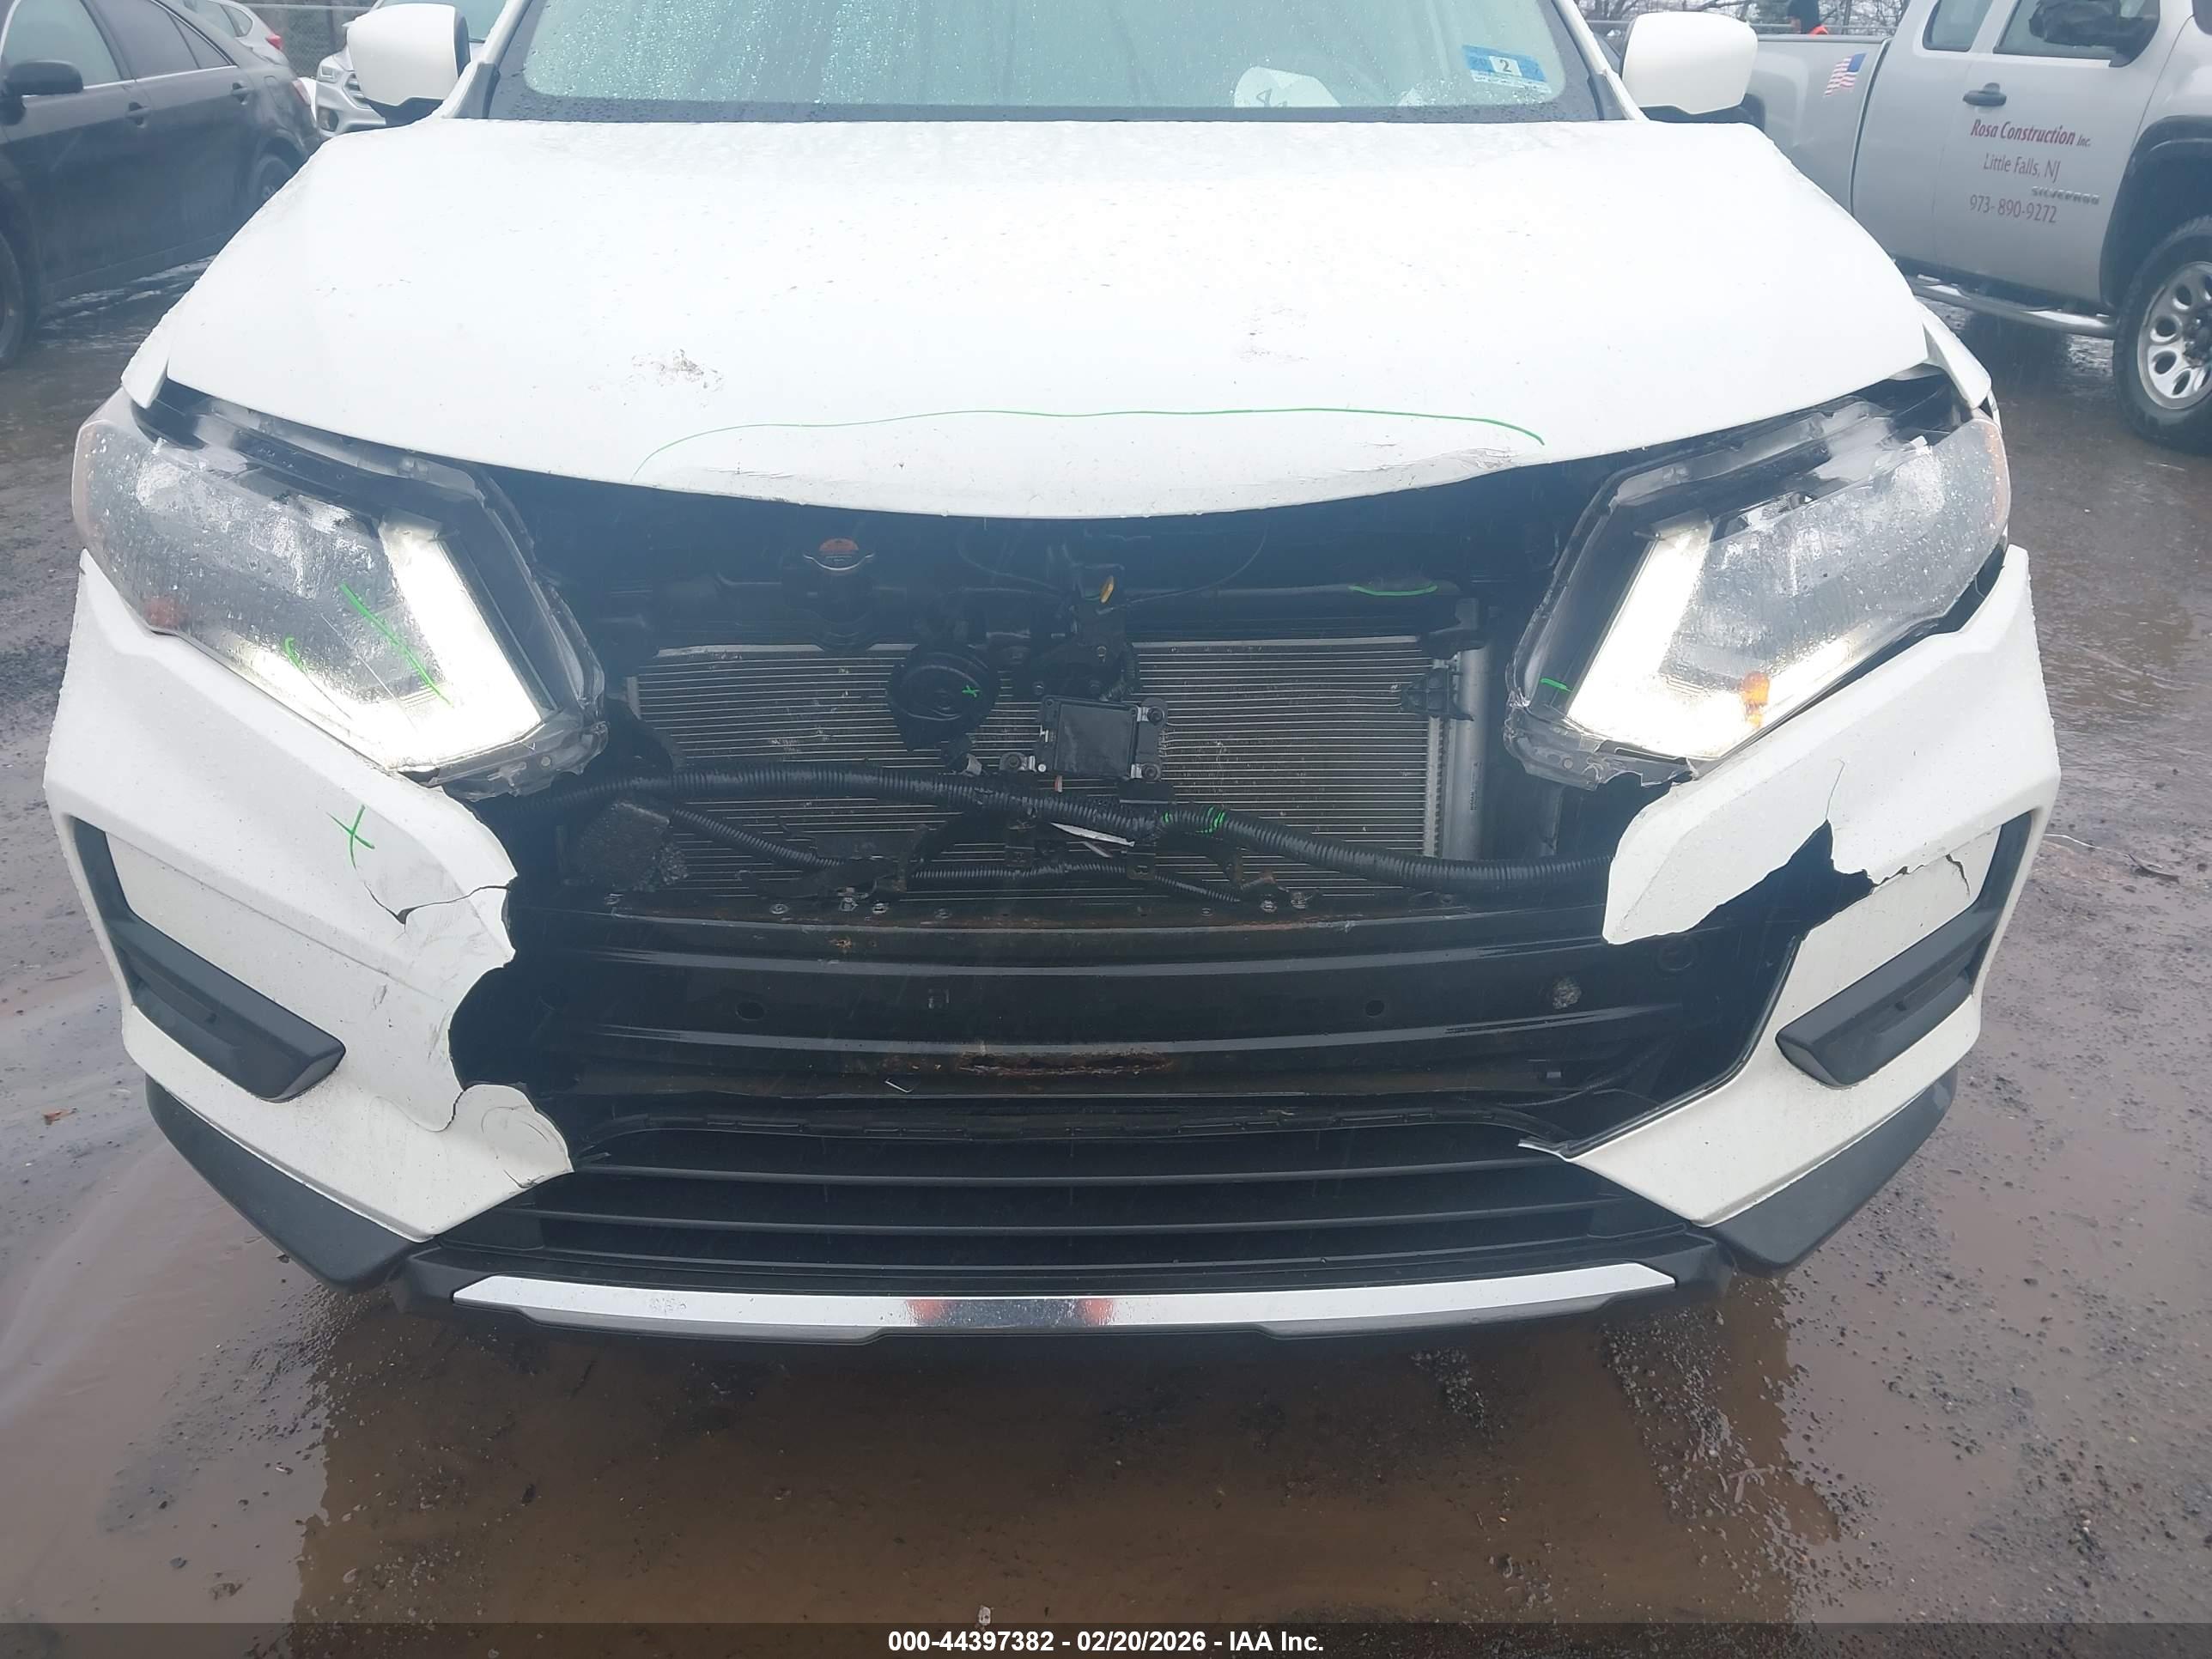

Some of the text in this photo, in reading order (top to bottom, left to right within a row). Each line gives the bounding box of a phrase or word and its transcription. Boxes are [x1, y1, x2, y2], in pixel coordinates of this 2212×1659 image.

[1499, 59, 1512, 73] 2
[1970, 118, 1999, 138] Rosa
[2000, 121, 2076, 146] Construction
[1983, 152, 2062, 184] Little Falls, NJ
